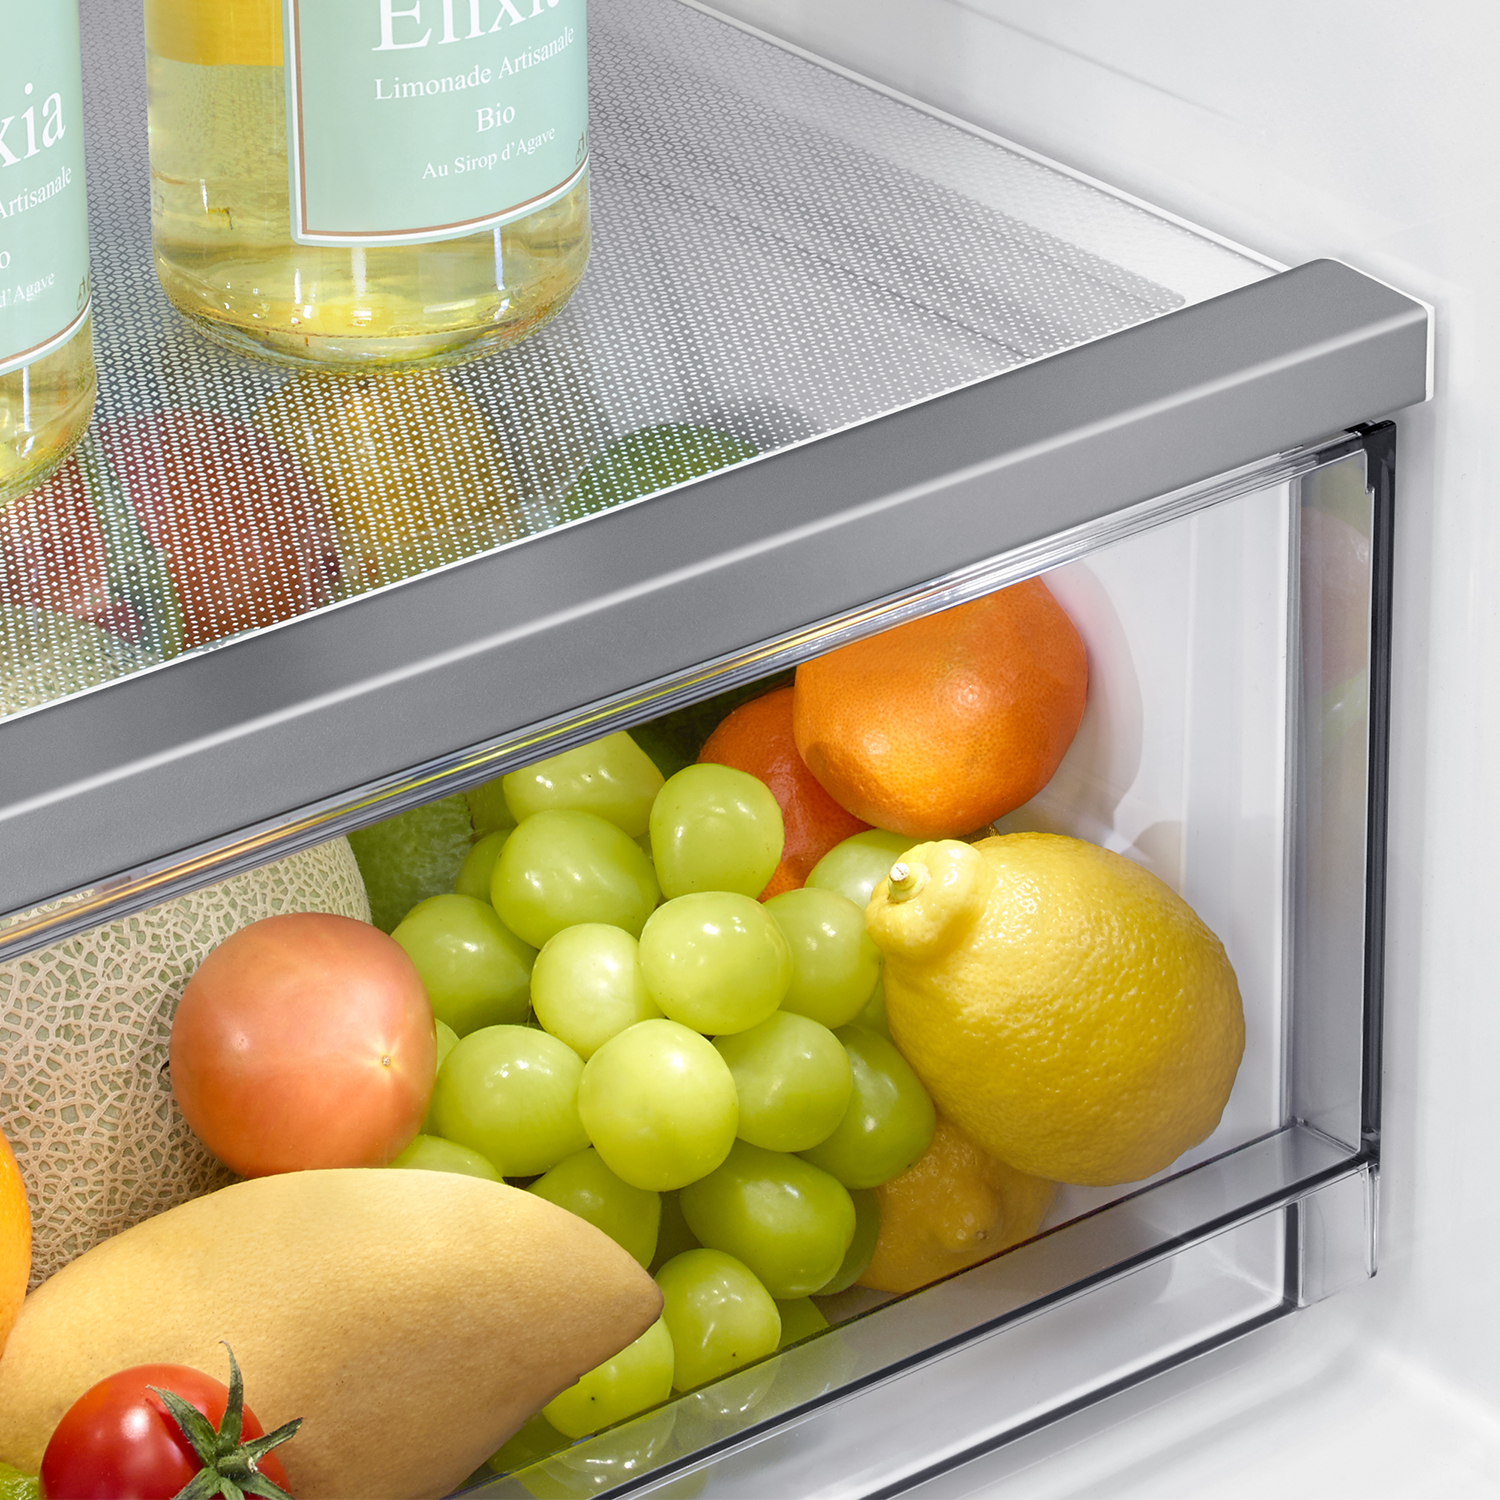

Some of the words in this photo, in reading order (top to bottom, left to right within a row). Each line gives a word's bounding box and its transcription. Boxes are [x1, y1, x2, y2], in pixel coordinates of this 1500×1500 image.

[374, 62, 493, 100] Limonade
[498, 25, 575, 80] Artisanale
[476, 102, 516, 133] Bio
[422, 161, 449, 180] Au
[454, 148, 498, 175] Sirop
